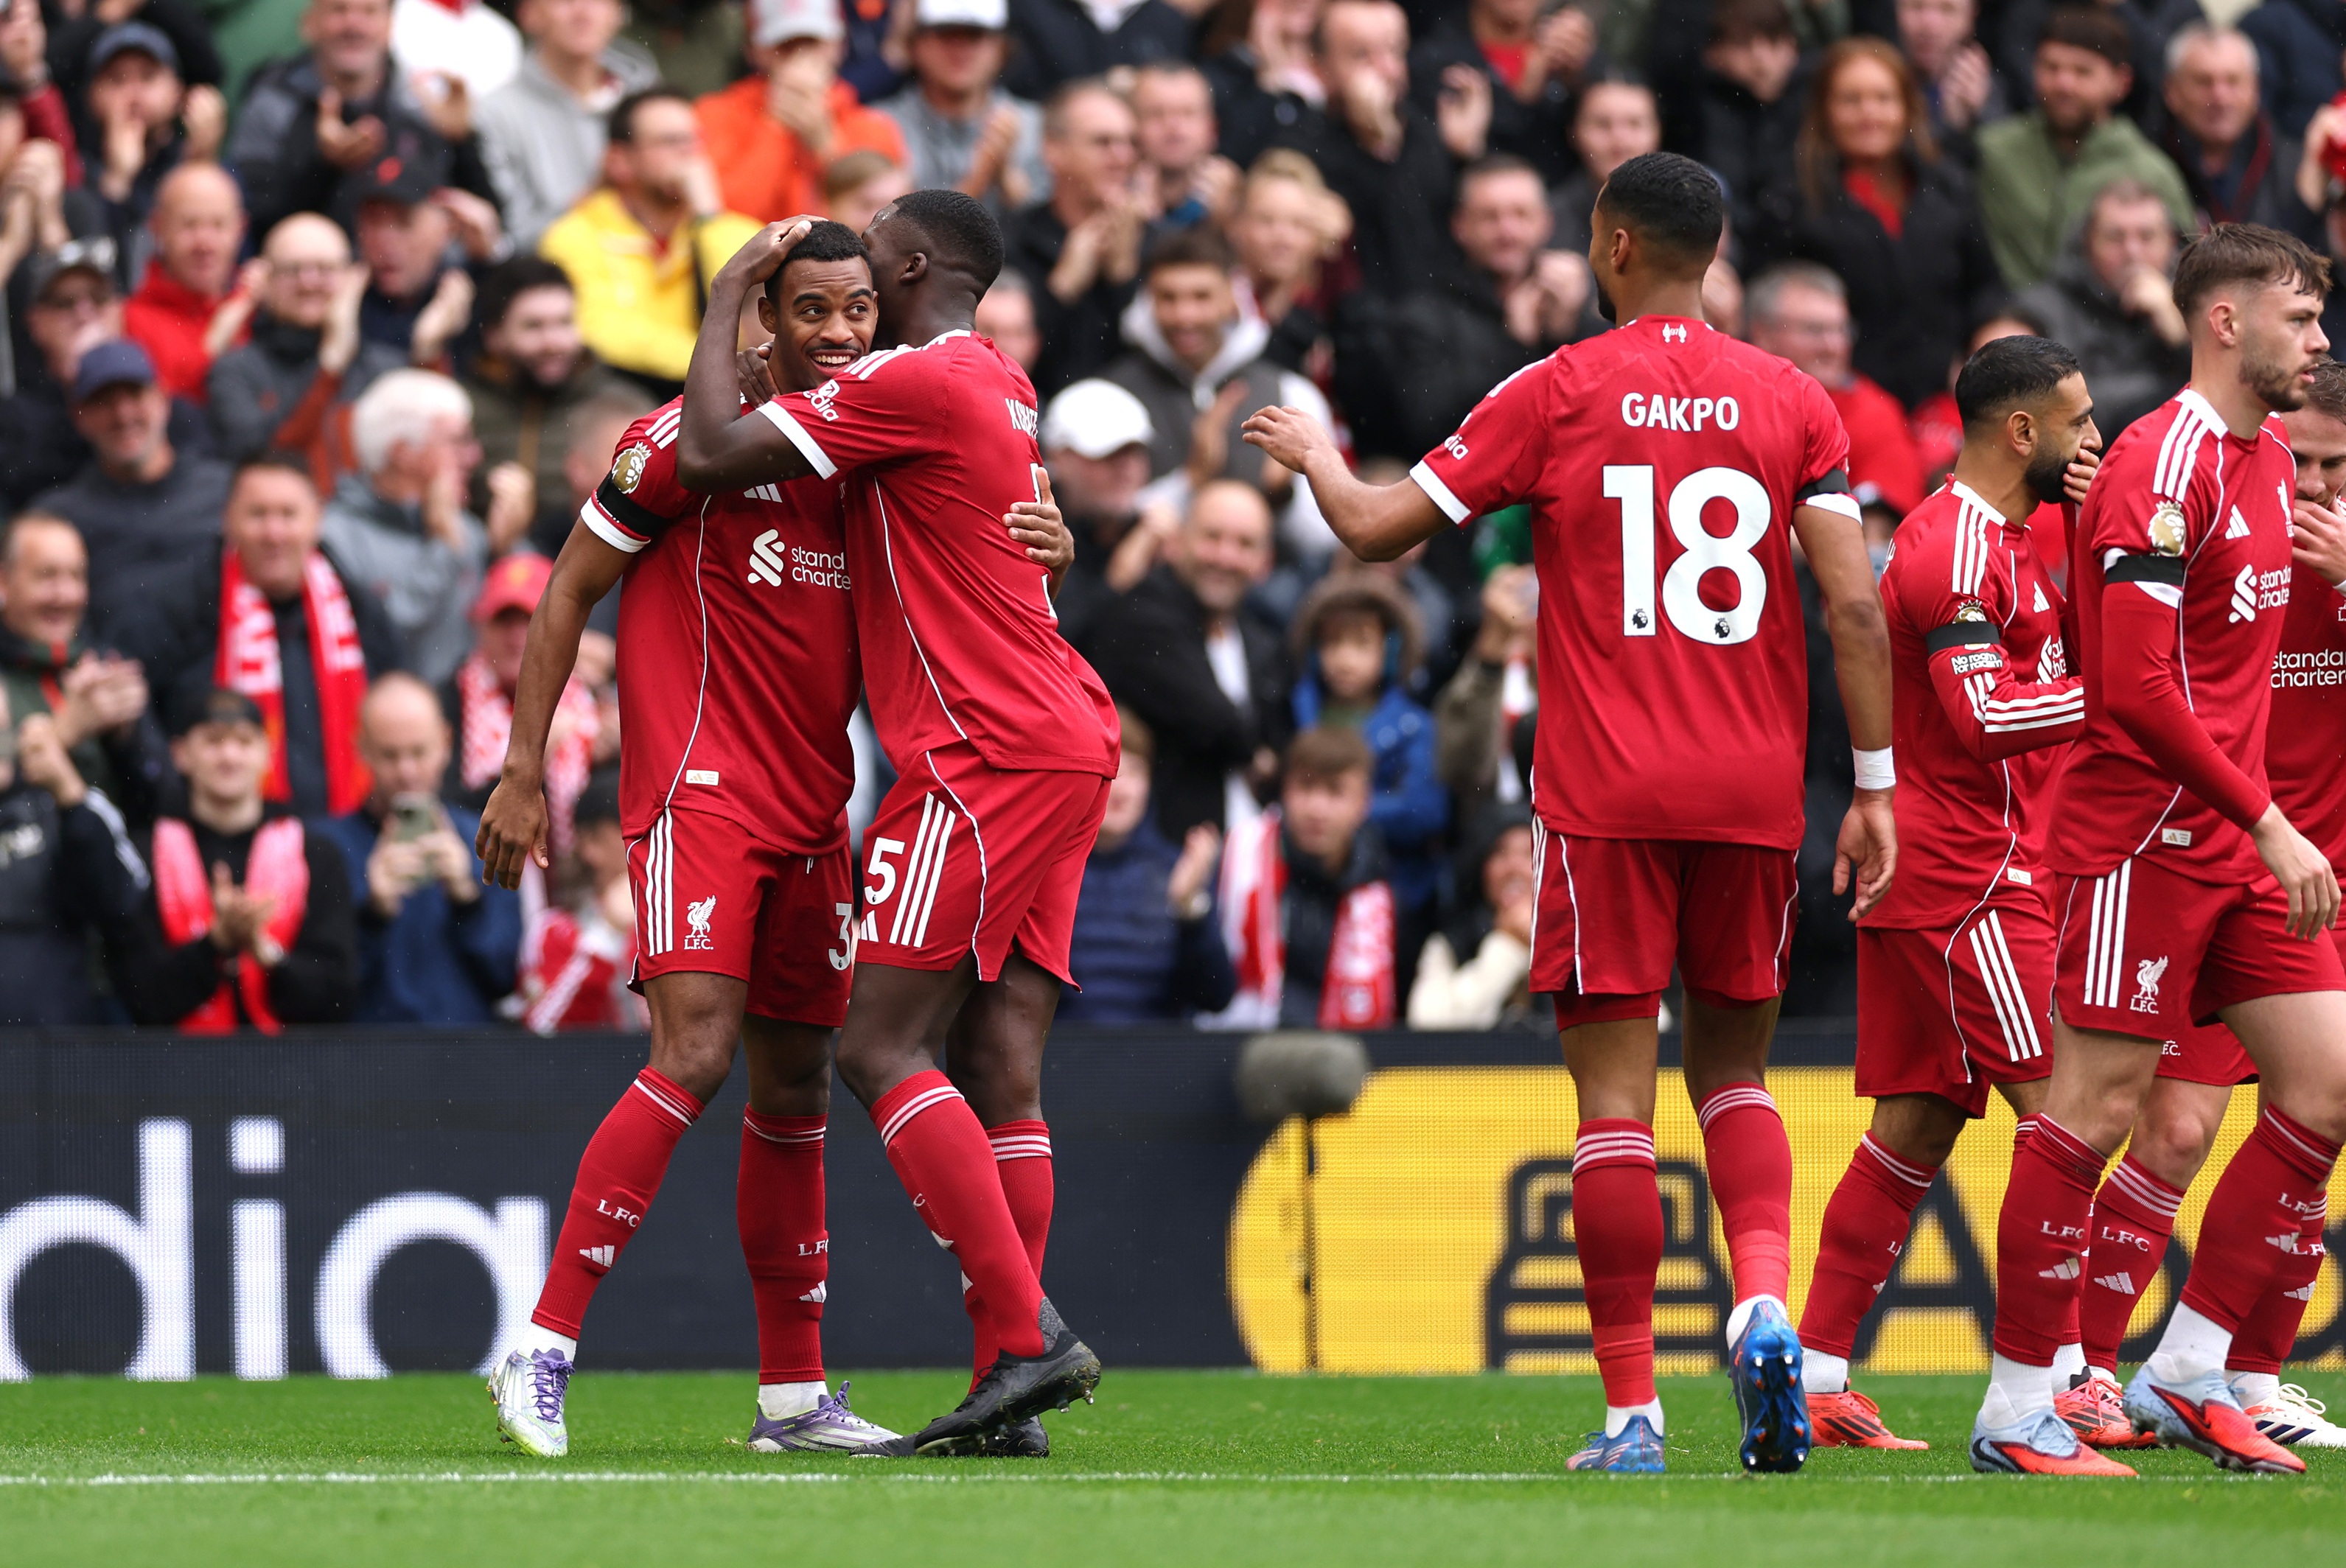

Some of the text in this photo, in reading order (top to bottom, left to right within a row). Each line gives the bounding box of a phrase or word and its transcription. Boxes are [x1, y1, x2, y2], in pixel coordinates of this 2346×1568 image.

[1621, 392, 1739, 432] GAKPO
[791, 546, 845, 570] stand
[1602, 464, 1771, 645] 18
[2272, 648, 2346, 670] standa
[2271, 668, 2346, 688] charter
[864, 837, 905, 905] 5
[684, 938, 714, 951] L.F.C.
[2129, 998, 2159, 1015] L.F.C.
[596, 1199, 640, 1228] LFC
[0, 1115, 551, 1382] dia
[2101, 1226, 2150, 1252] LFC
